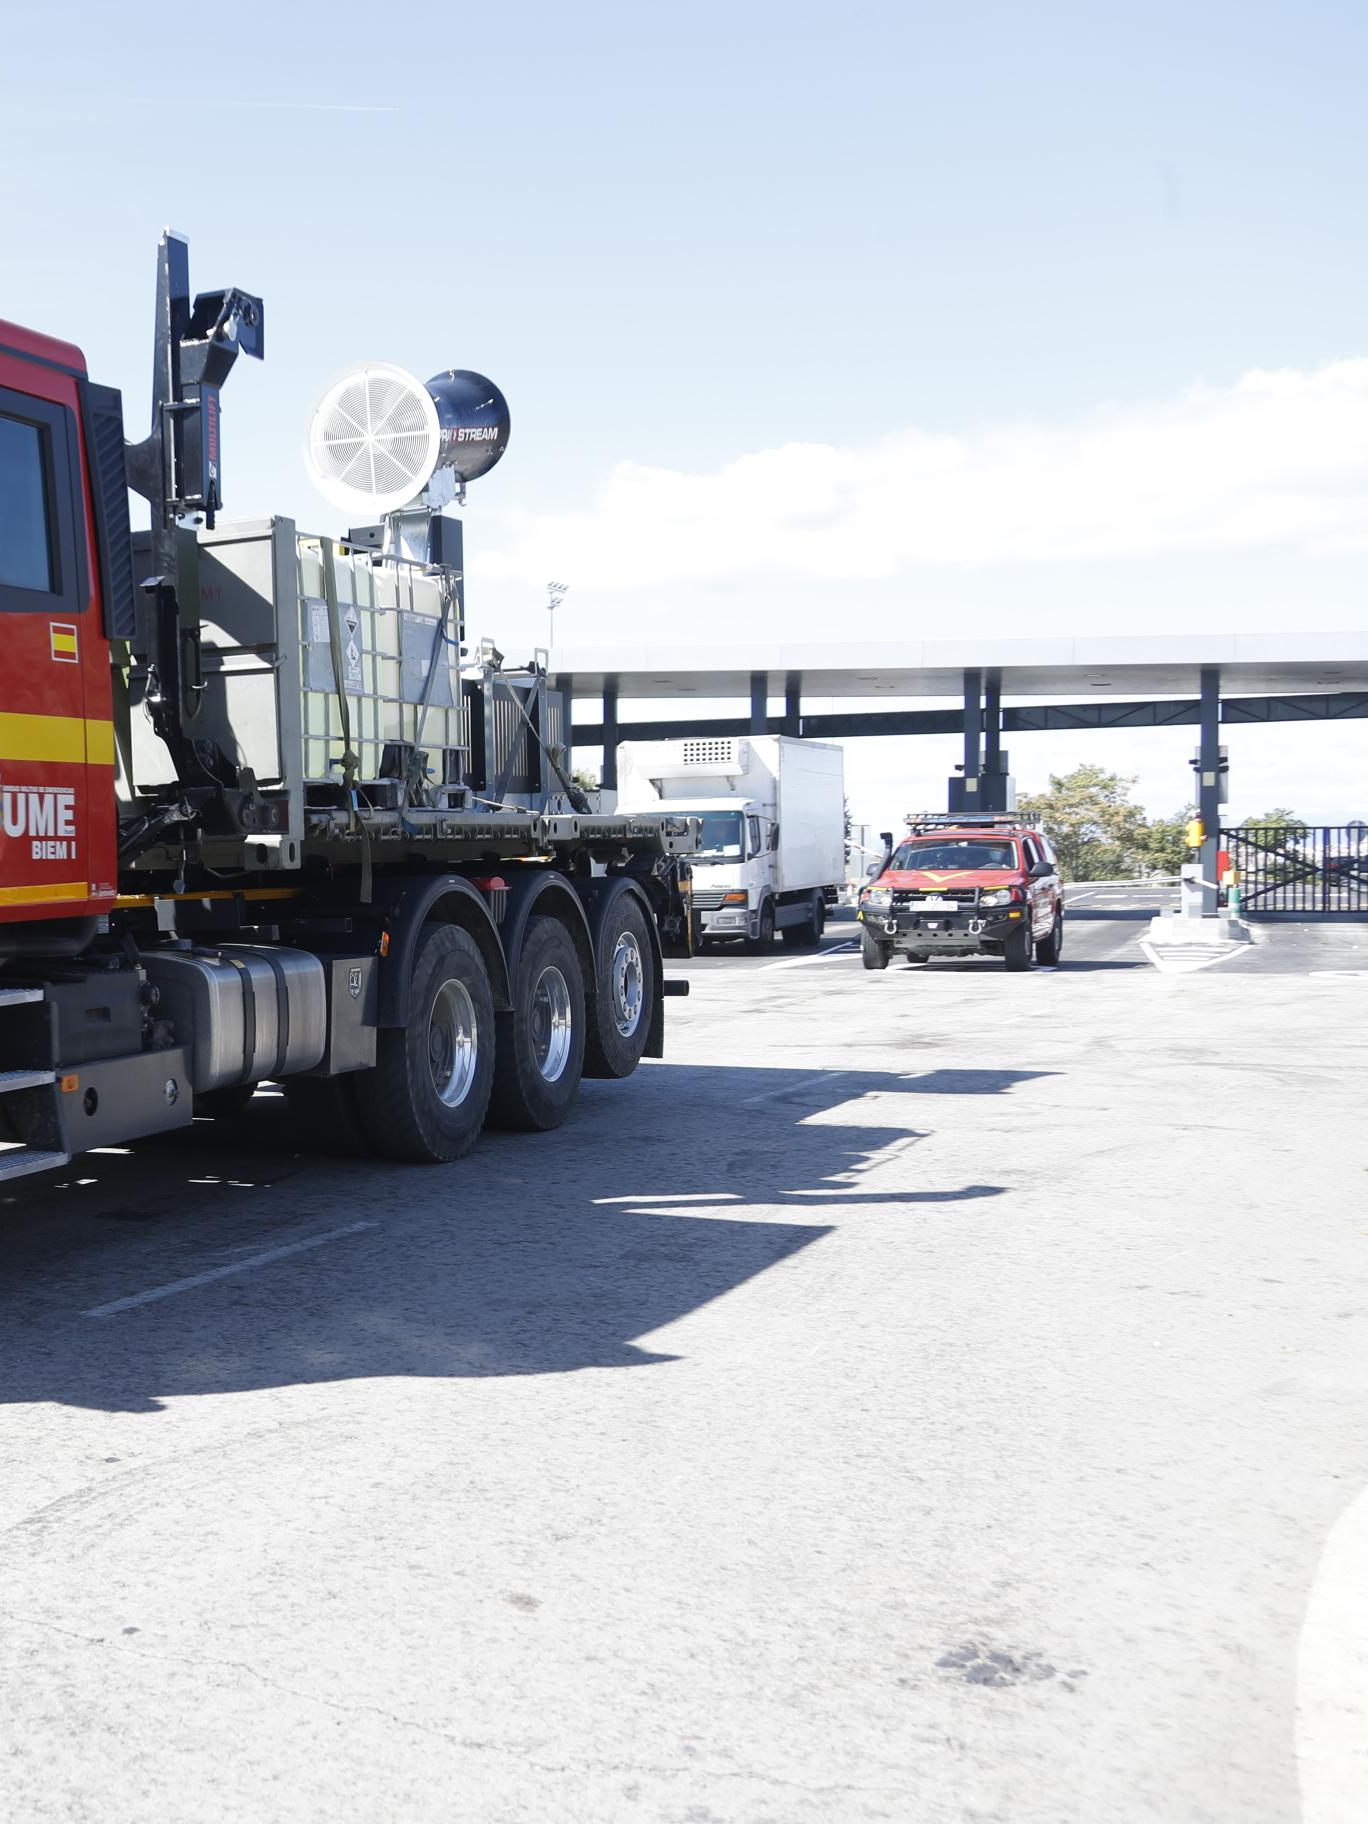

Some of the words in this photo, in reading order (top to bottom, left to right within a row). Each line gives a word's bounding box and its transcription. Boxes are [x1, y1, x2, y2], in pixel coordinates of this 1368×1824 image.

[208, 394, 217, 461] MULTILIFT
[458, 427, 499, 441] STREAM
[3, 792, 76, 838] UME
[32, 840, 68, 860] BIEM
